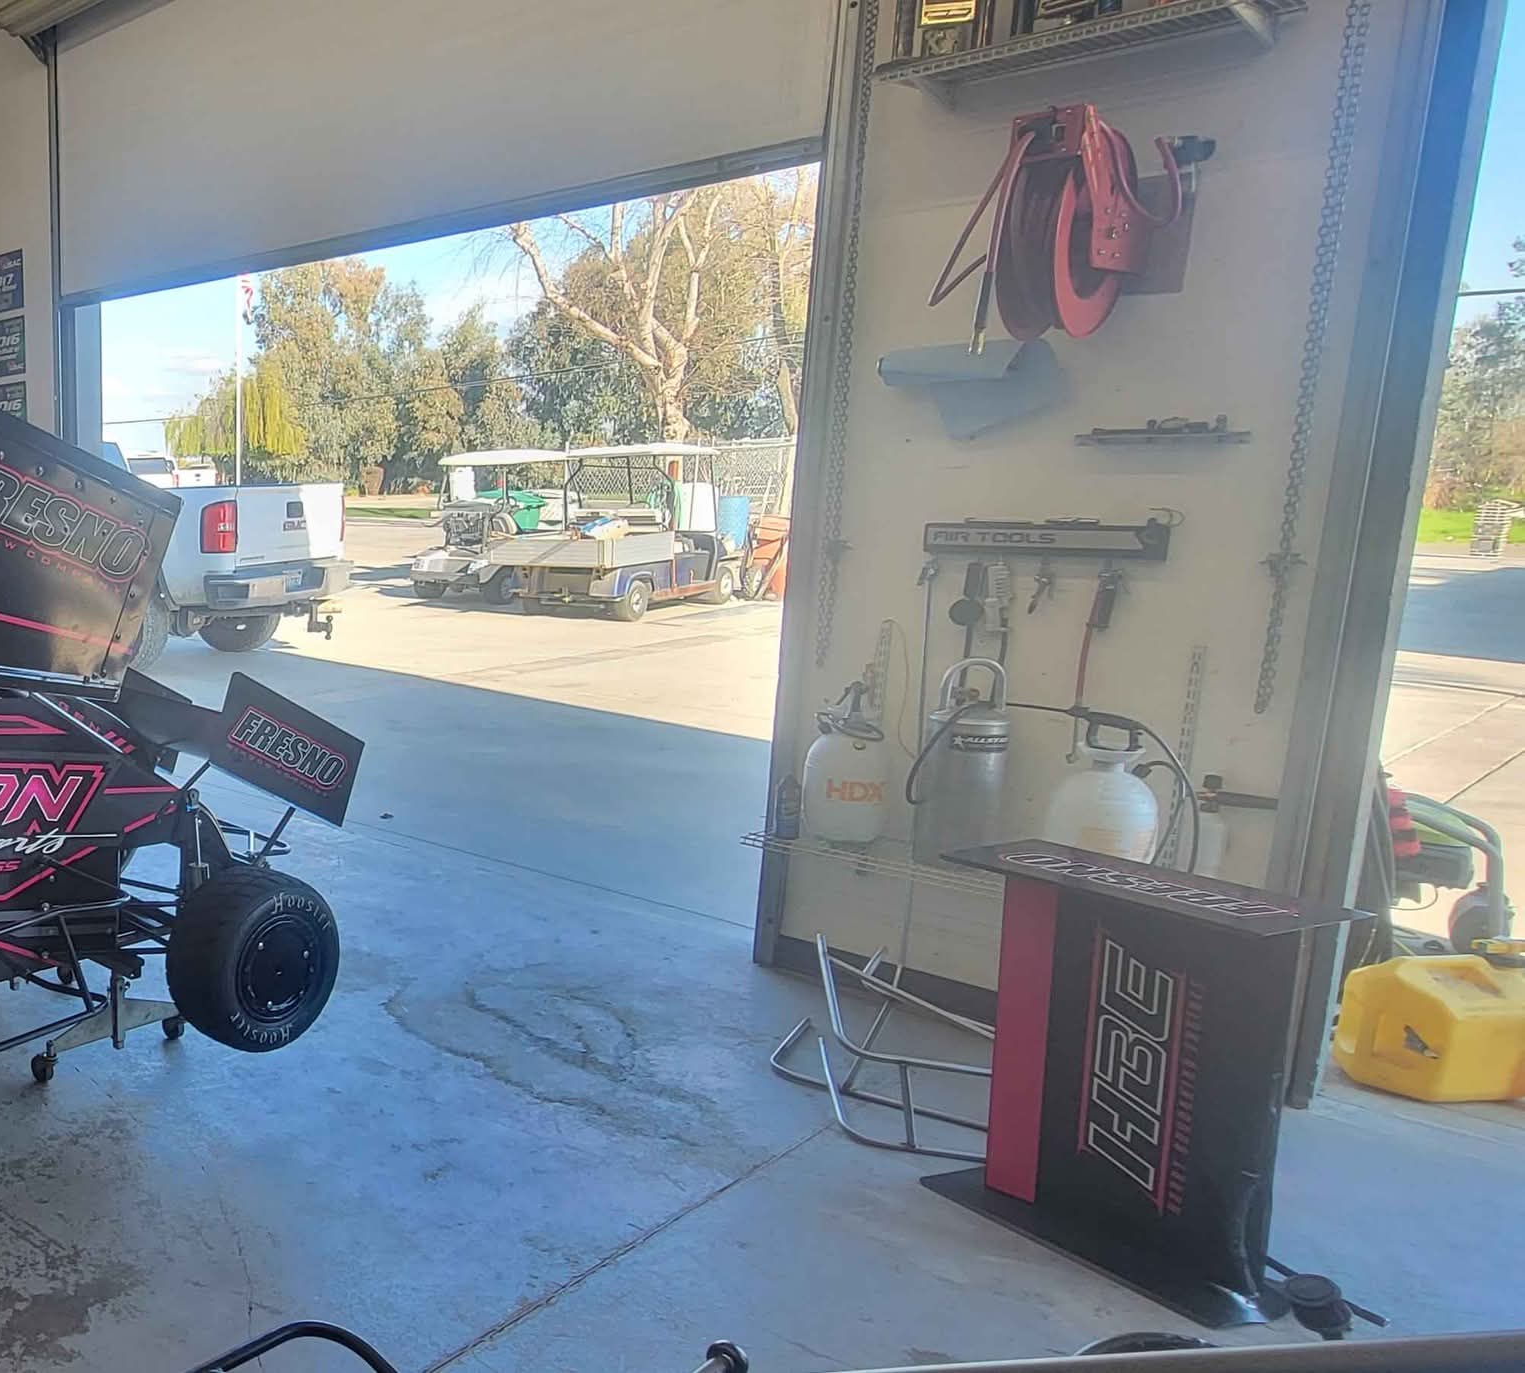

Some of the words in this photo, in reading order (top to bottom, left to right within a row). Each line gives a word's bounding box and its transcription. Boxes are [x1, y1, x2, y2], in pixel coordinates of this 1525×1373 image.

[933, 529, 970, 543] AIR
[976, 531, 1057, 545] TOOLS
[231, 709, 346, 786] FRESNO
[825, 778, 888, 803] HDX
[1087, 937, 1176, 1194] HBE
